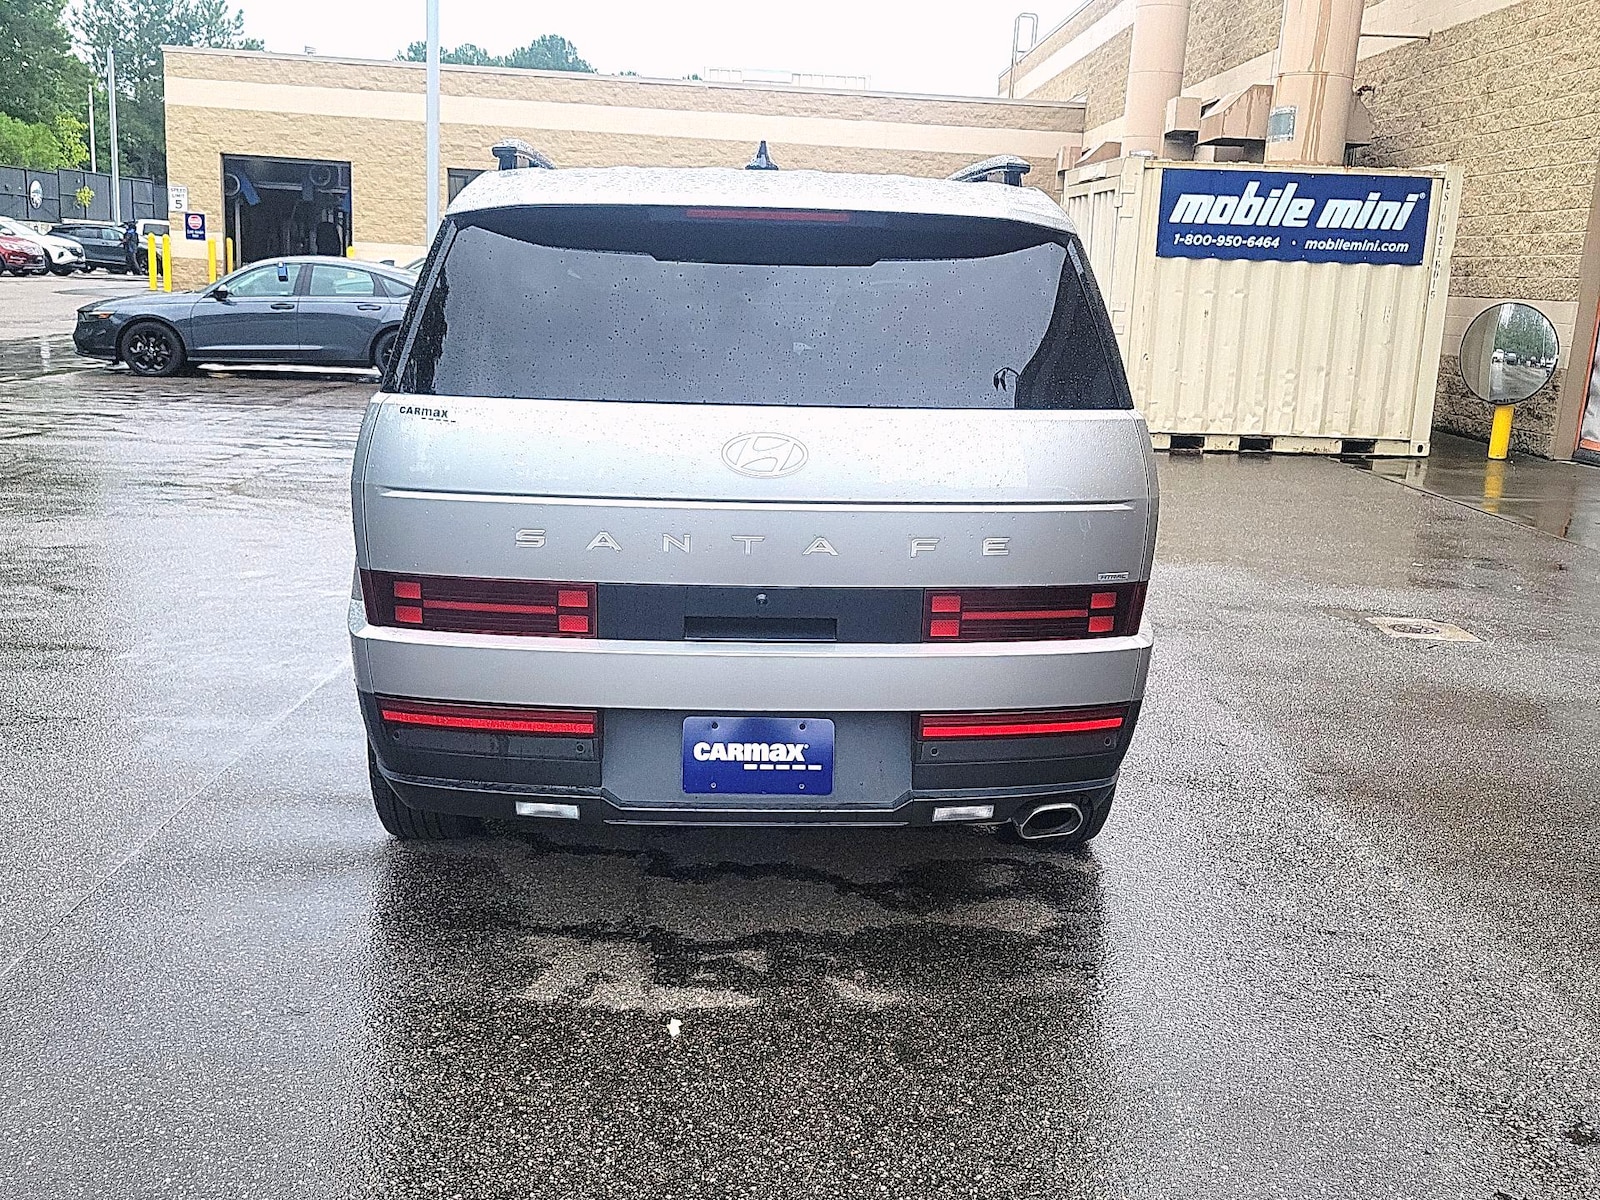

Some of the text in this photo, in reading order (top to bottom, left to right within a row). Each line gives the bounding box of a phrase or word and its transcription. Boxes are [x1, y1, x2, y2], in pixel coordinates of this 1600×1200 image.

[175, 200, 183, 209] 5
[1168, 181, 1315, 228] mobile
[1173, 233, 1409, 254] 1-800-950-6464 mobilemini.com
[514, 527, 1012, 558] SANTA FE
